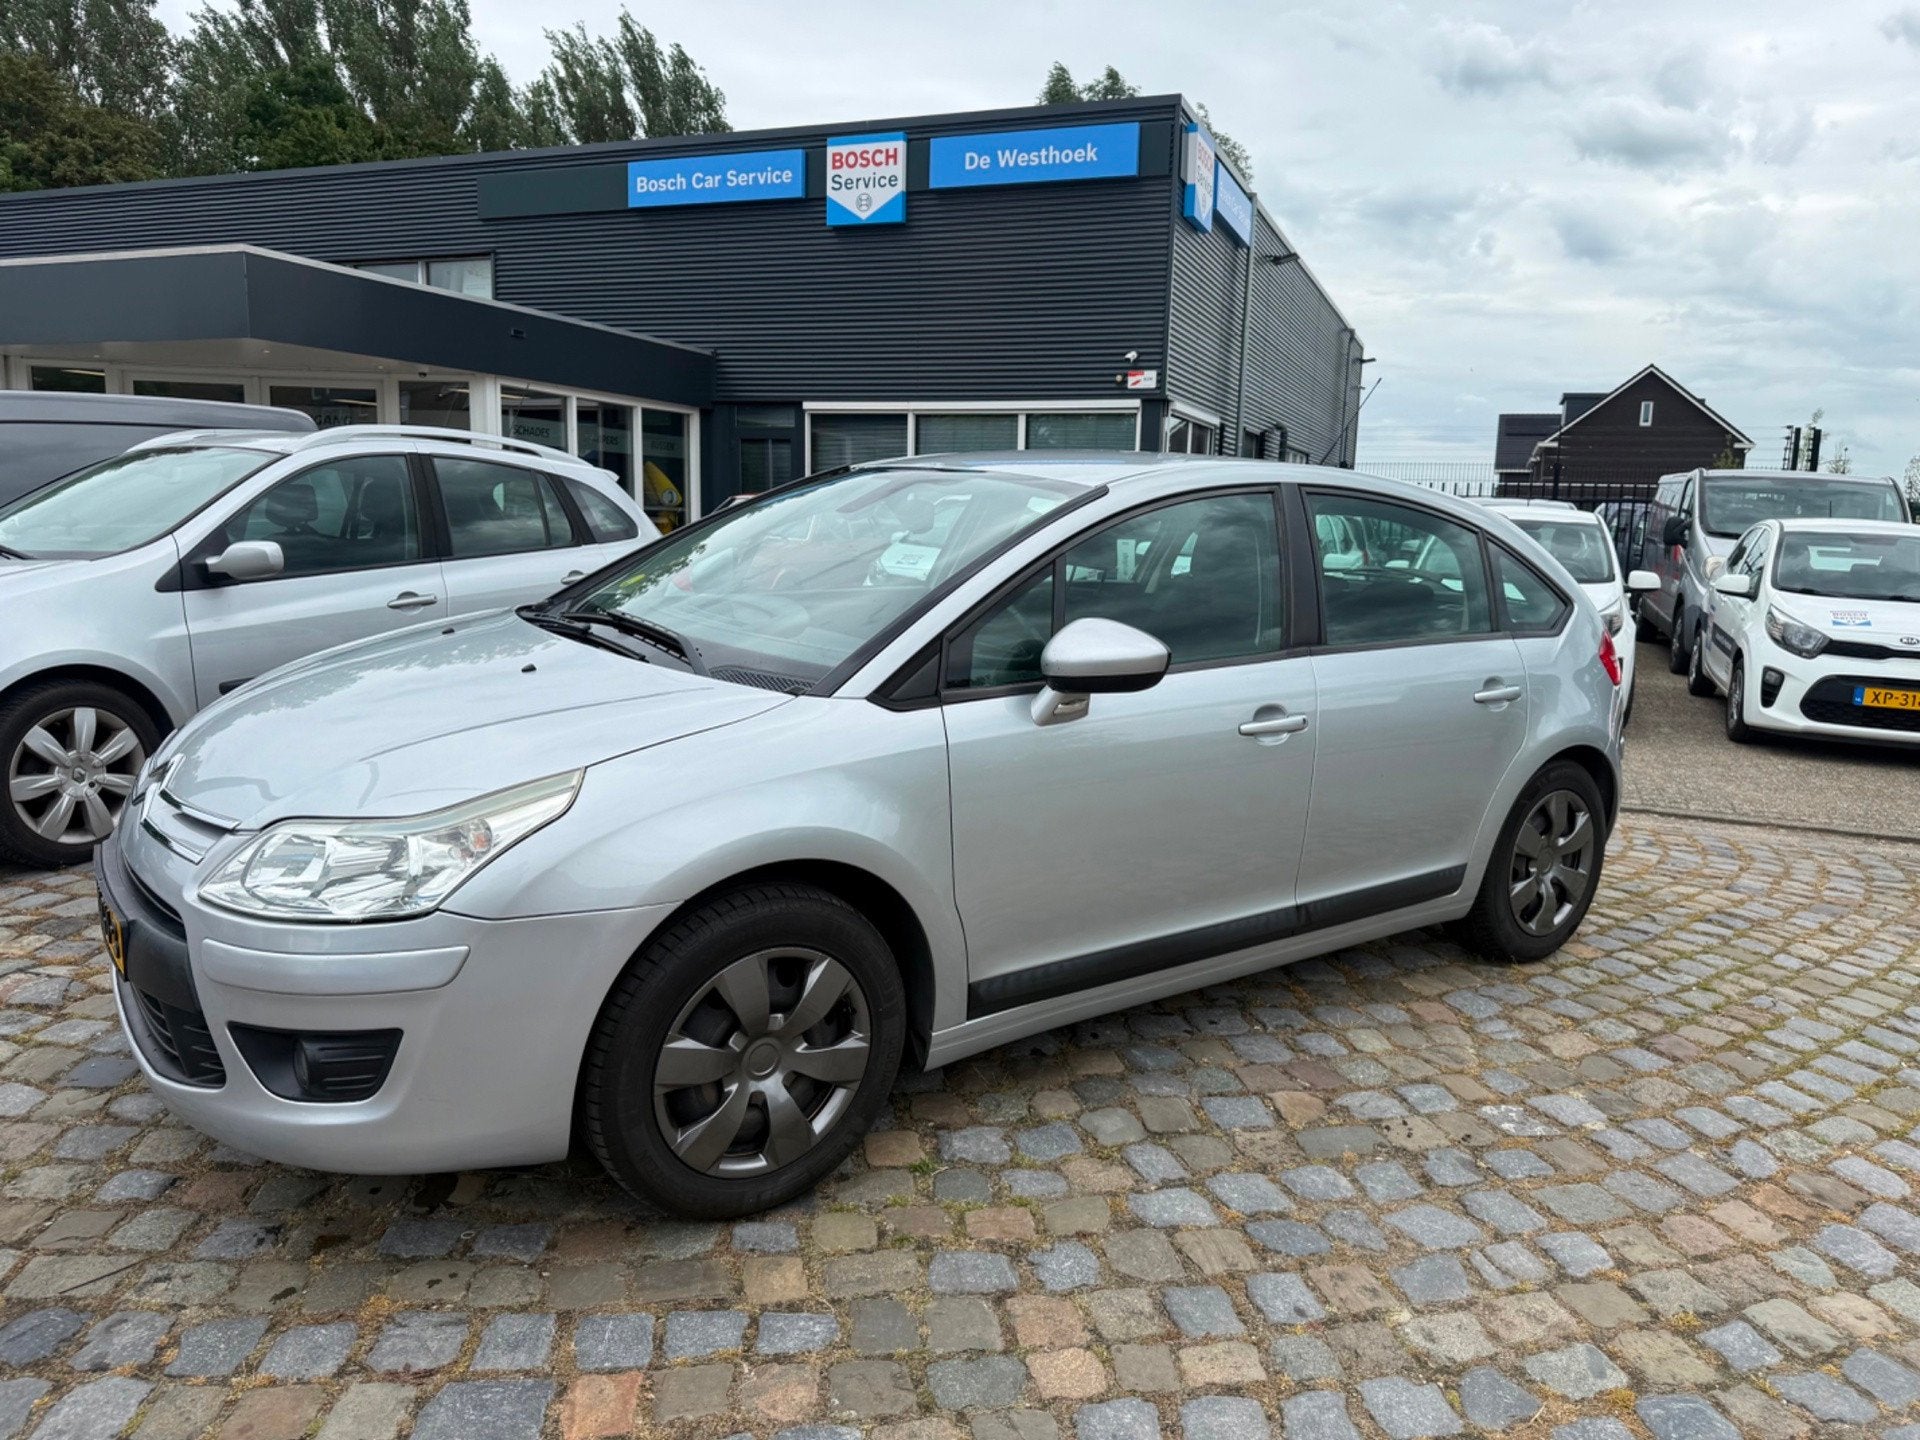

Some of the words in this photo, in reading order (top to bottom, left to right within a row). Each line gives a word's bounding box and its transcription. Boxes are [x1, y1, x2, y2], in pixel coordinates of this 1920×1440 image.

[831, 147, 898, 170] BOSCH
[964, 151, 990, 170] De
[997, 142, 1098, 168] Westhoek
[636, 173, 687, 193] Bosch
[691, 172, 722, 189] Car
[726, 166, 793, 187] Service
[831, 171, 898, 191] Service
[1871, 691, 1920, 707] XP-31
